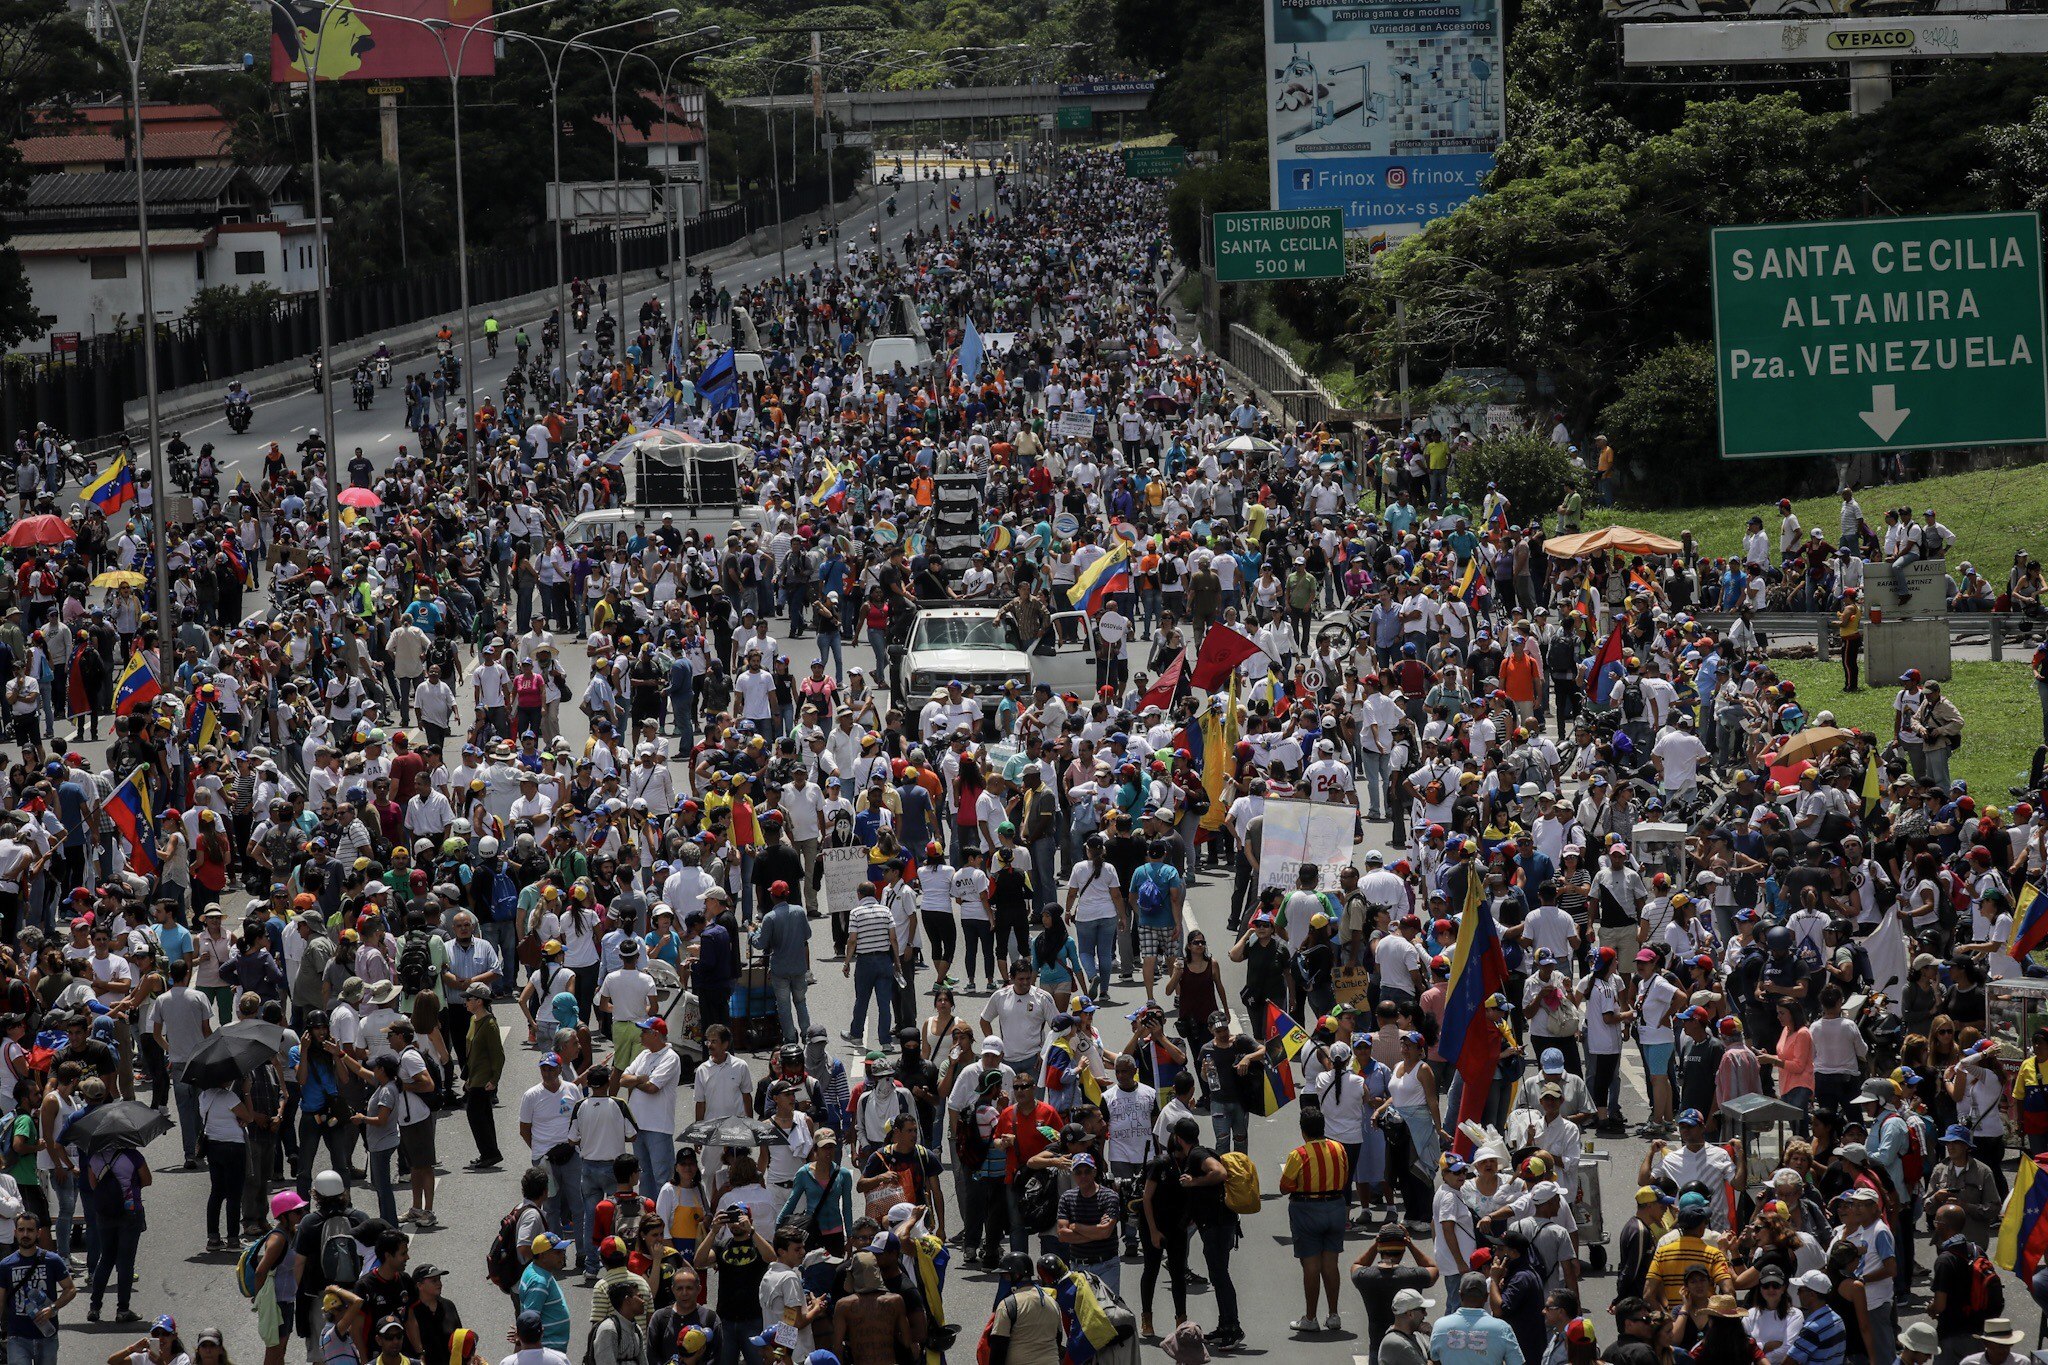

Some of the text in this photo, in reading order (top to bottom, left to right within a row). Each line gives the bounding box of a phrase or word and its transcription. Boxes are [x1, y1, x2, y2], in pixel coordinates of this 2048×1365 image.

[1335, 7, 1461, 21] Amplia gama de modelos
[1372, 24, 1416, 34] Variedad
[1435, 20, 1491, 32] Accesorios
[1836, 31, 1906, 47] VEPACO
[1318, 170, 1376, 187] Frinox
[1226, 215, 1332, 233] DISTRIBUIDOR
[1220, 236, 1339, 255] SANTA CECILIA
[1255, 258, 1306, 274] 500 M
[1732, 236, 2025, 281] SANTA CECILIA
[1781, 287, 1981, 328] ALTAMIRA
[1730, 333, 2033, 380] Pza. VENEZUELA
[367, 766, 382, 776] GAP
[1317, 774, 1337, 792] 24
[823, 846, 867, 862] MADURO
